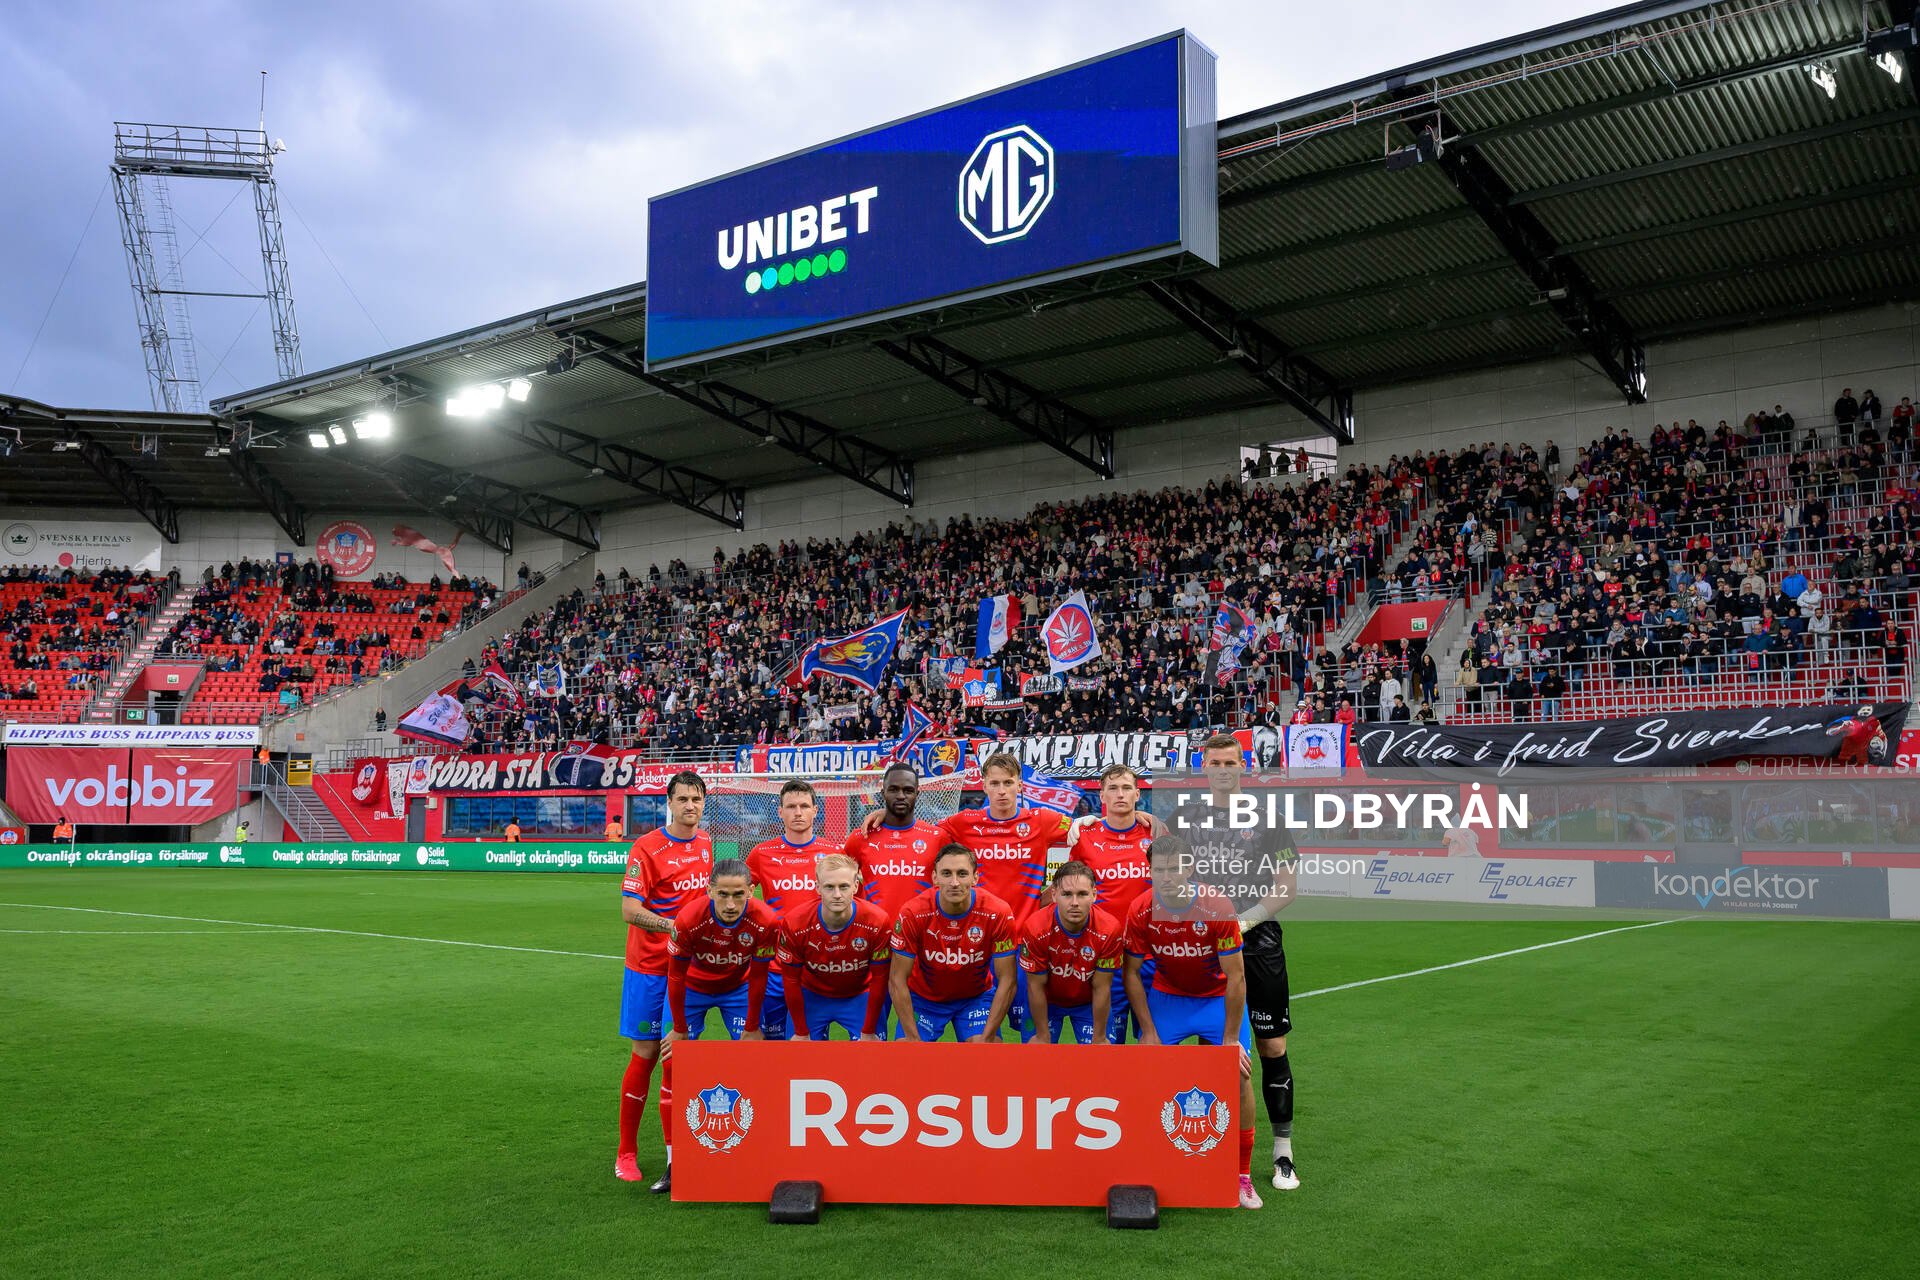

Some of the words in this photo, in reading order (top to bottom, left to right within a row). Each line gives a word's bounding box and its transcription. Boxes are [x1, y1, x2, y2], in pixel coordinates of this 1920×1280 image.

[967, 136, 1045, 233] MG
[717, 186, 878, 270] UNIBET
[39, 534, 88, 542] SVENSKA
[93, 535, 132, 543] FINANS
[76, 554, 111, 567] Hjerta
[9, 729, 86, 739] KLIPPANS
[90, 730, 130, 740] BUSS
[135, 730, 211, 740] KLIPPANS
[215, 730, 255, 740] BUSS
[977, 732, 1187, 769] KOMPANIET
[1360, 728, 1460, 764] Vila
[1474, 740, 1493, 762] i
[1497, 727, 1605, 777] frid
[429, 755, 498, 790] SÖDRA
[602, 754, 637, 787] 85
[45, 764, 215, 807] vobbiz
[27, 850, 81, 864] Ovanligt
[86, 850, 153, 864] okrångliga
[159, 849, 209, 864] försäkringar
[229, 846, 242, 856] Solid
[272, 850, 304, 864] Ovanligt
[306, 849, 348, 865] okrångliga
[351, 849, 401, 864] försäkringar
[428, 847, 445, 857] Solid
[486, 851, 526, 866] Ovanligt
[529, 850, 583, 867] okrångliga
[588, 851, 630, 866] försäkri
[974, 844, 1031, 859] vobbiz
[1191, 841, 1246, 861] vobbiz
[870, 859, 926, 876] vobbiz
[772, 874, 815, 890] vobb
[1389, 872, 1454, 884] BOLAGET
[1505, 875, 1577, 888] BOLAGET
[1653, 866, 1819, 899] kondektor
[925, 948, 984, 965] vobbiz
[1152, 942, 1213, 957] vobbiz
[807, 959, 869, 973] vobbiz
[1251, 1011, 1272, 1021] Fibio
[789, 1079, 1122, 1151] Resurs
